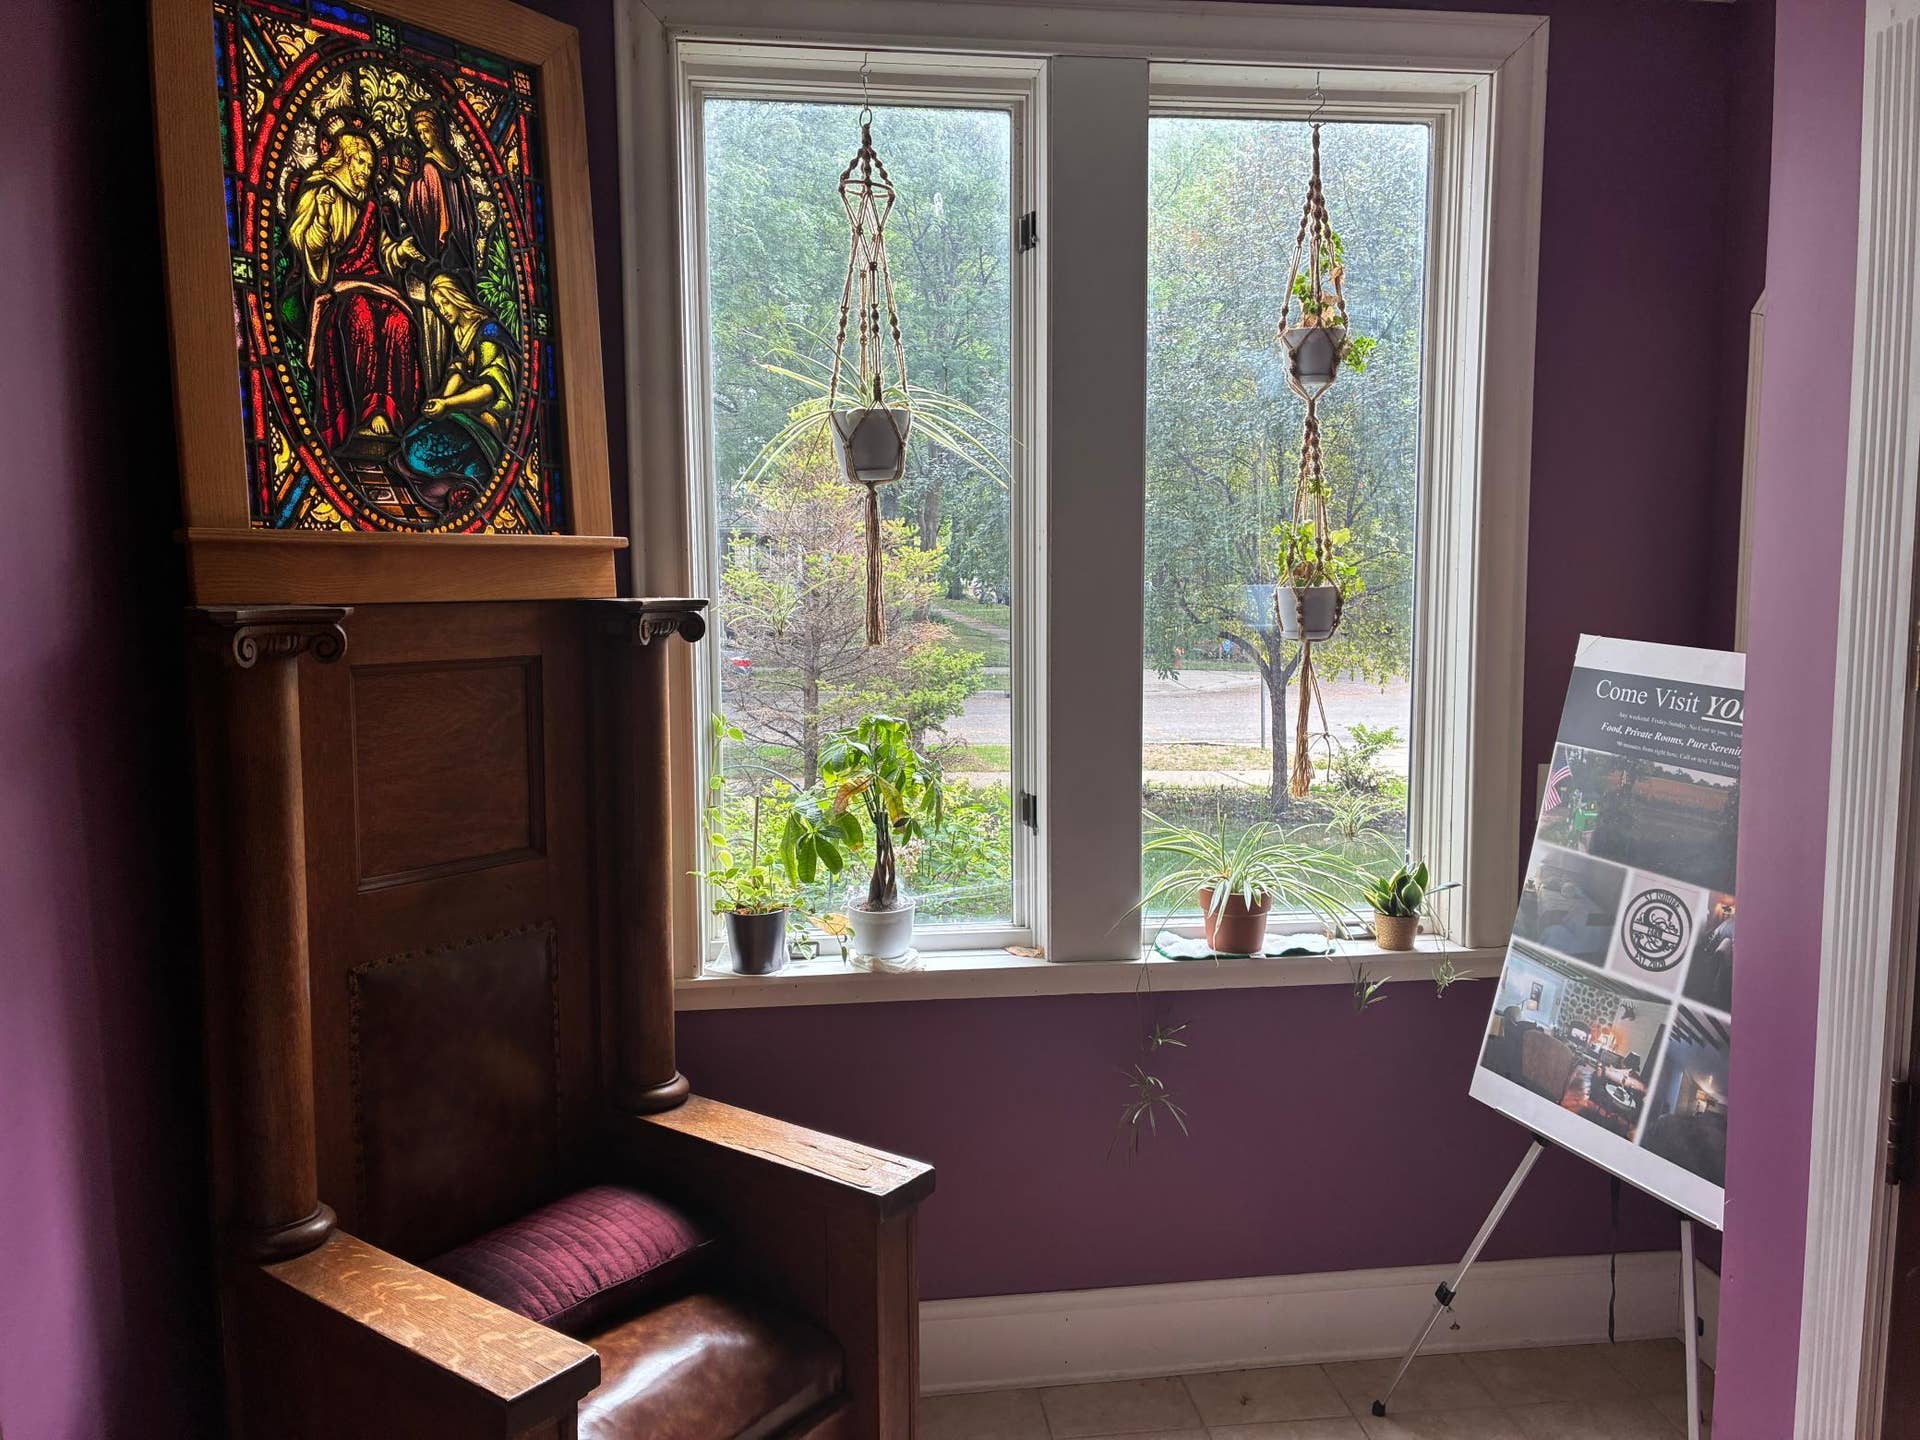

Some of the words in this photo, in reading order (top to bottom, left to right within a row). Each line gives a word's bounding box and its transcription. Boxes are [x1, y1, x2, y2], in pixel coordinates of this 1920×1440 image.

[1596, 679, 1648, 704] Come
[1656, 688, 1700, 713] Visit
[1601, 722, 1623, 734] Food,
[1624, 726, 1653, 739] Private
[1654, 731, 1684, 746] Rooms,
[1686, 738, 1708, 750] Pure
